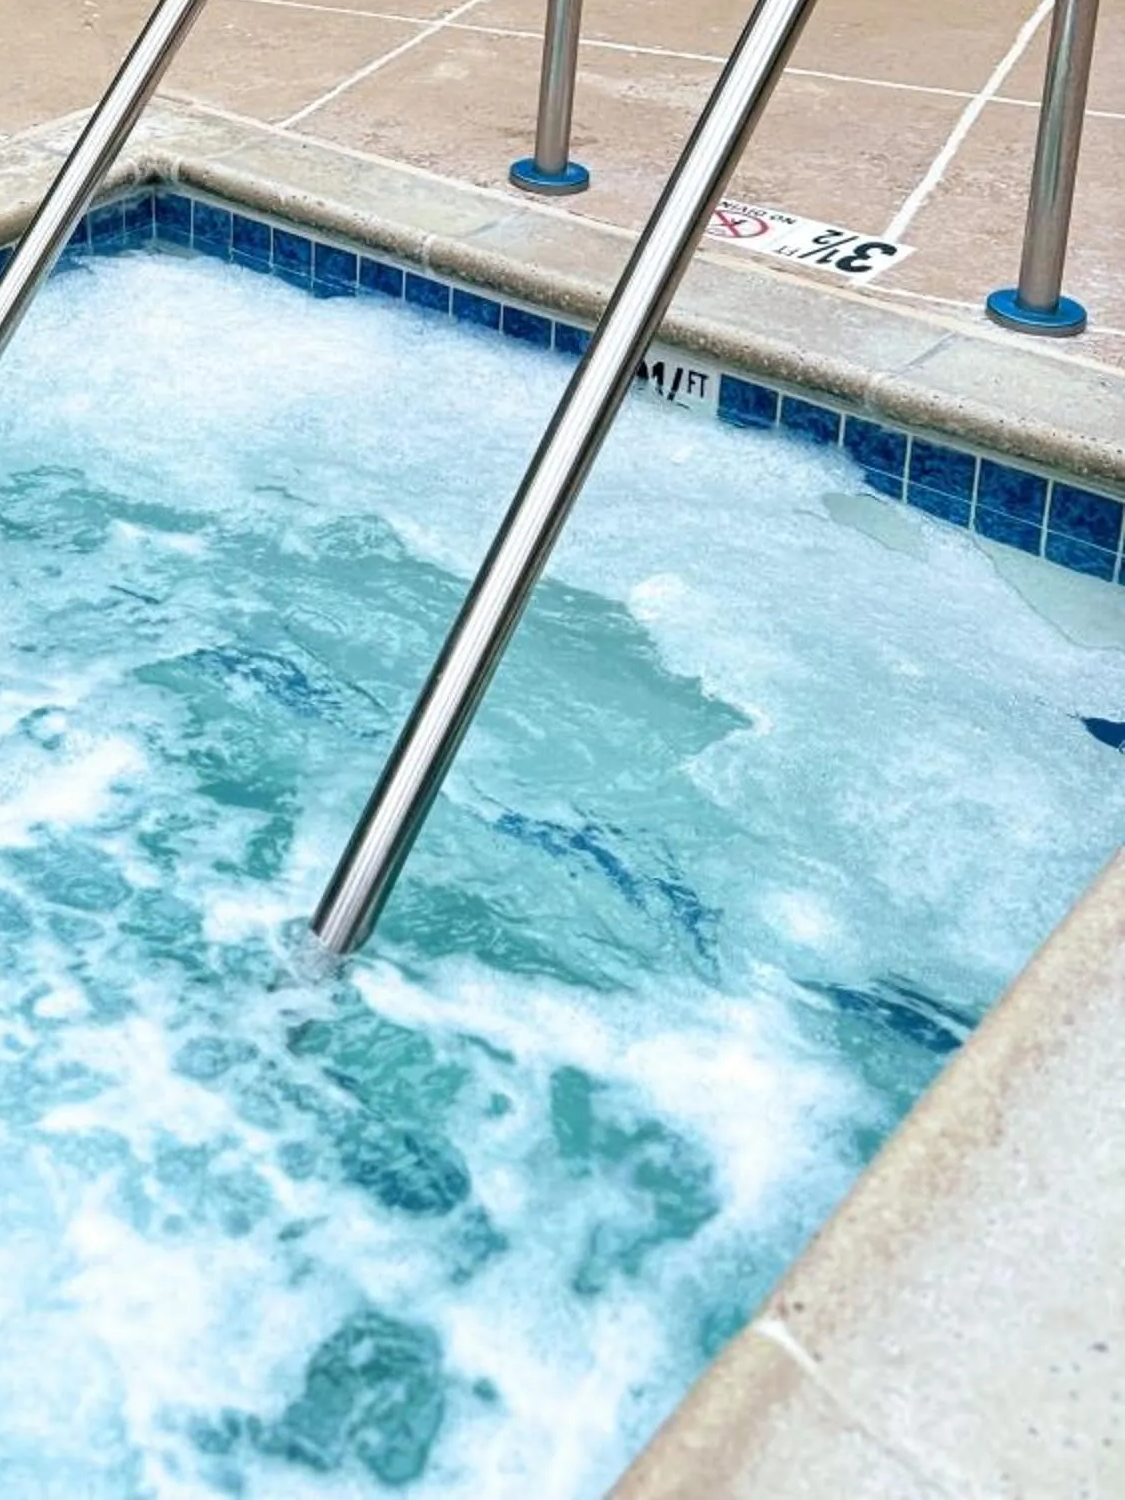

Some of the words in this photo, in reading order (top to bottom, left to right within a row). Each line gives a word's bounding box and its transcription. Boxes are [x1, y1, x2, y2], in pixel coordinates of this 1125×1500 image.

[721, 200, 768, 217] DIVIN
[769, 214, 797, 225] NO
[778, 245, 797, 257] FT
[687, 369, 709, 399] FT
